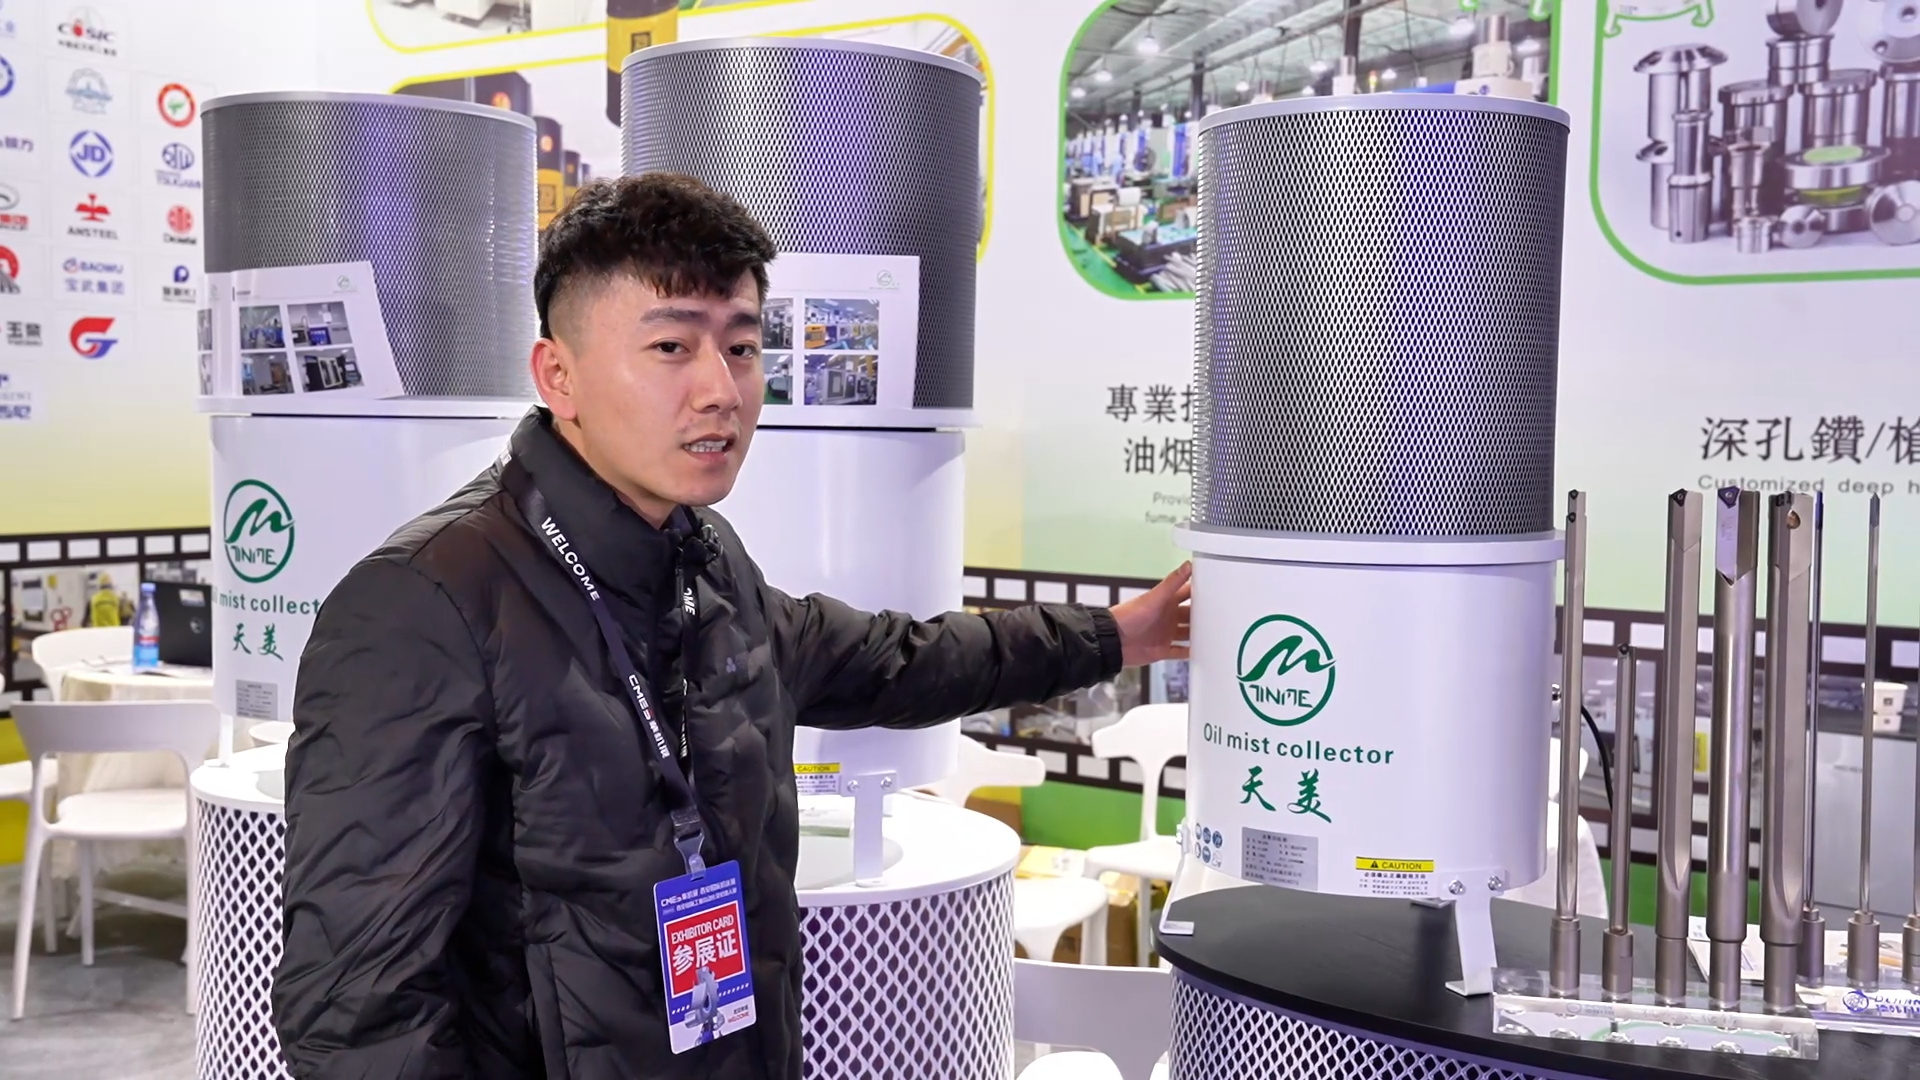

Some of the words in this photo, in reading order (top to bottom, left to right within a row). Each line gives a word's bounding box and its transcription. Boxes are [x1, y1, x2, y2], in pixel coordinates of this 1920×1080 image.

[66, 226, 119, 240] ANSTEEL
[1838, 478, 1894, 496] deep
[541, 517, 600, 602] WELCOME
[219, 589, 246, 611] mist
[233, 622, 284, 661] 天美
[1203, 723, 1222, 745] Oil
[1227, 732, 1270, 754] mist
[1277, 740, 1394, 764] collector
[1239, 765, 1332, 824] 天美
[1381, 861, 1422, 870] CAUTION
[672, 921, 712, 944] EXHIBITOR
[712, 914, 734, 931] CARD
[672, 928, 739, 977] 参展证
